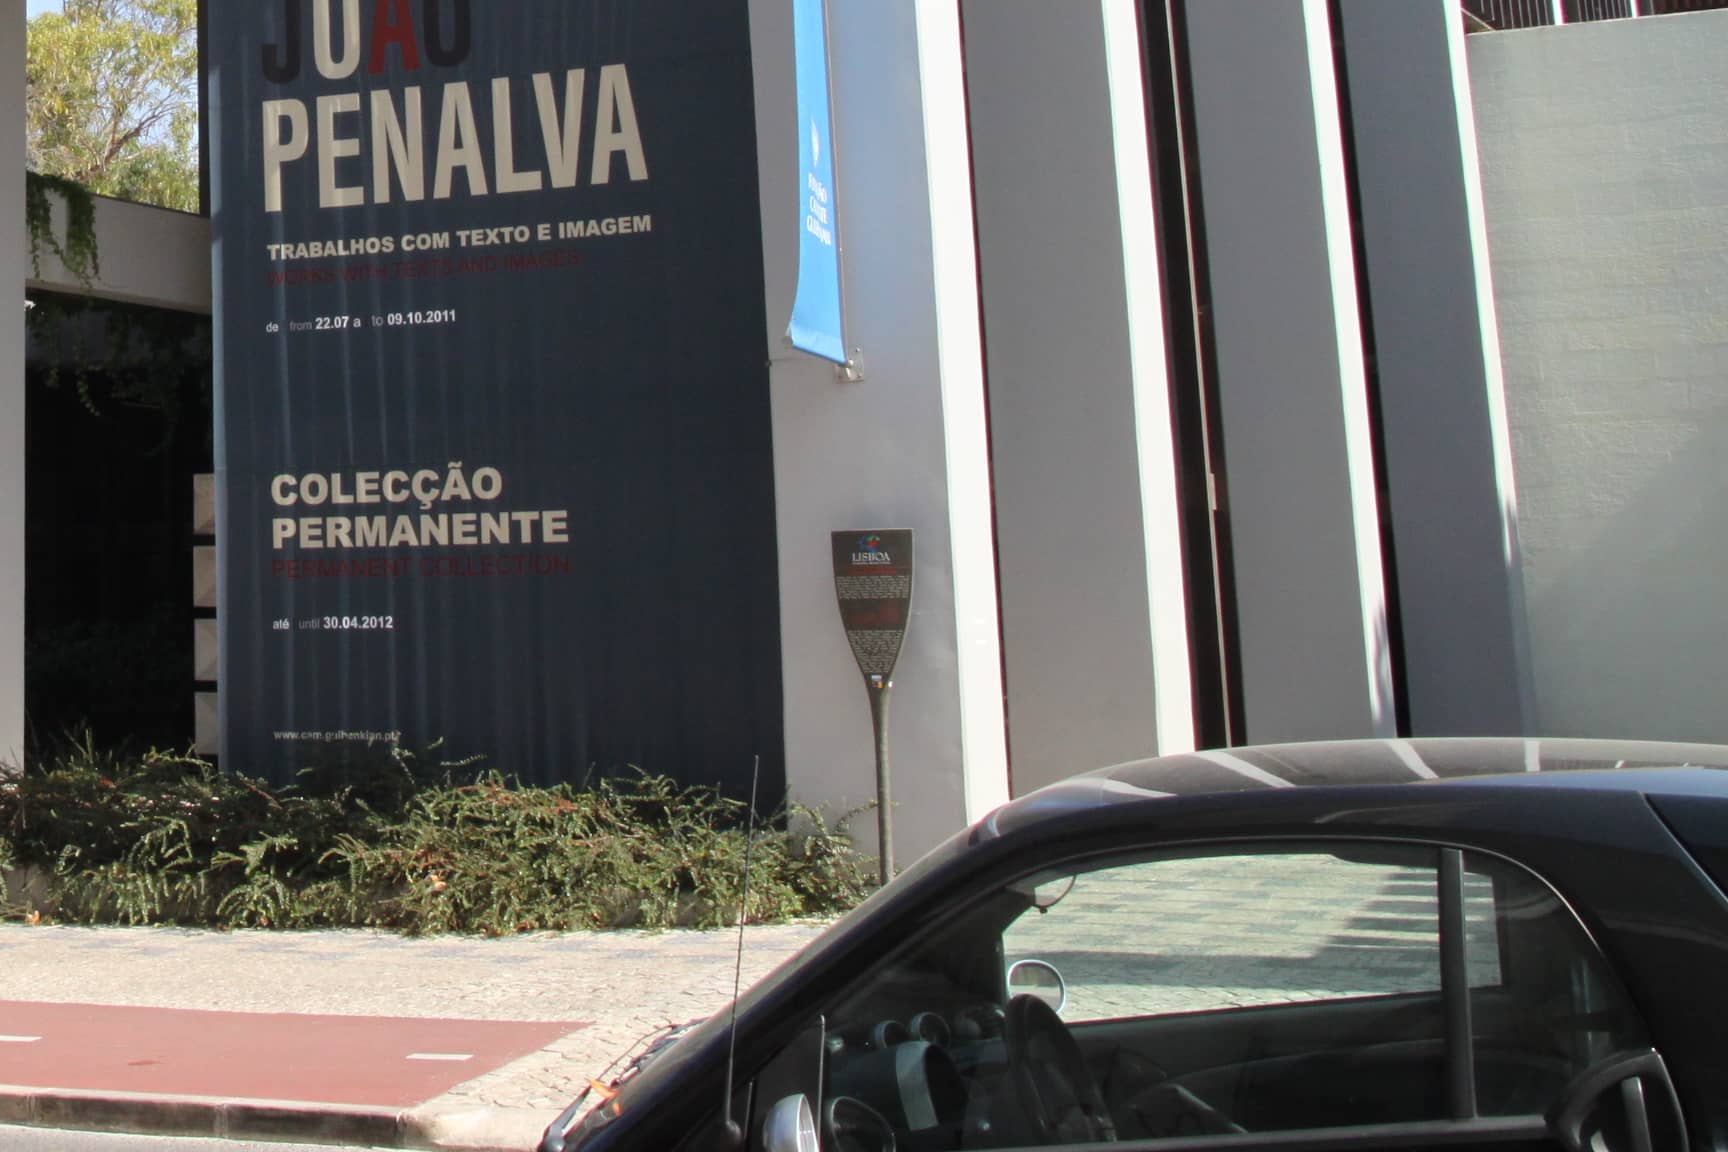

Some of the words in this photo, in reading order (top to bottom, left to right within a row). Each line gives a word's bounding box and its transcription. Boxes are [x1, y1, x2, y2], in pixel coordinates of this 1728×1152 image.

[261, 63, 649, 213] PENALVA
[267, 236, 395, 261] TRABALHOS
[401, 231, 450, 251] COM
[456, 225, 530, 247] TEXTO
[537, 223, 551, 241] E
[558, 215, 652, 239] IMAGEM
[266, 322, 279, 333] de
[289, 321, 313, 332] from
[315, 316, 350, 330] 22.07
[353, 317, 362, 328] a
[372, 315, 384, 327] to
[387, 309, 457, 326] 09.10.2011
[271, 461, 503, 509] COLECÇÃO
[272, 510, 569, 550] PERMANENTE
[272, 556, 413, 579] PERMANENT
[419, 553, 572, 578] COLLECTION
[852, 551, 891, 562] LISBOA
[273, 618, 290, 630] até
[299, 617, 320, 629] until
[323, 615, 393, 629] 30.04.2012
